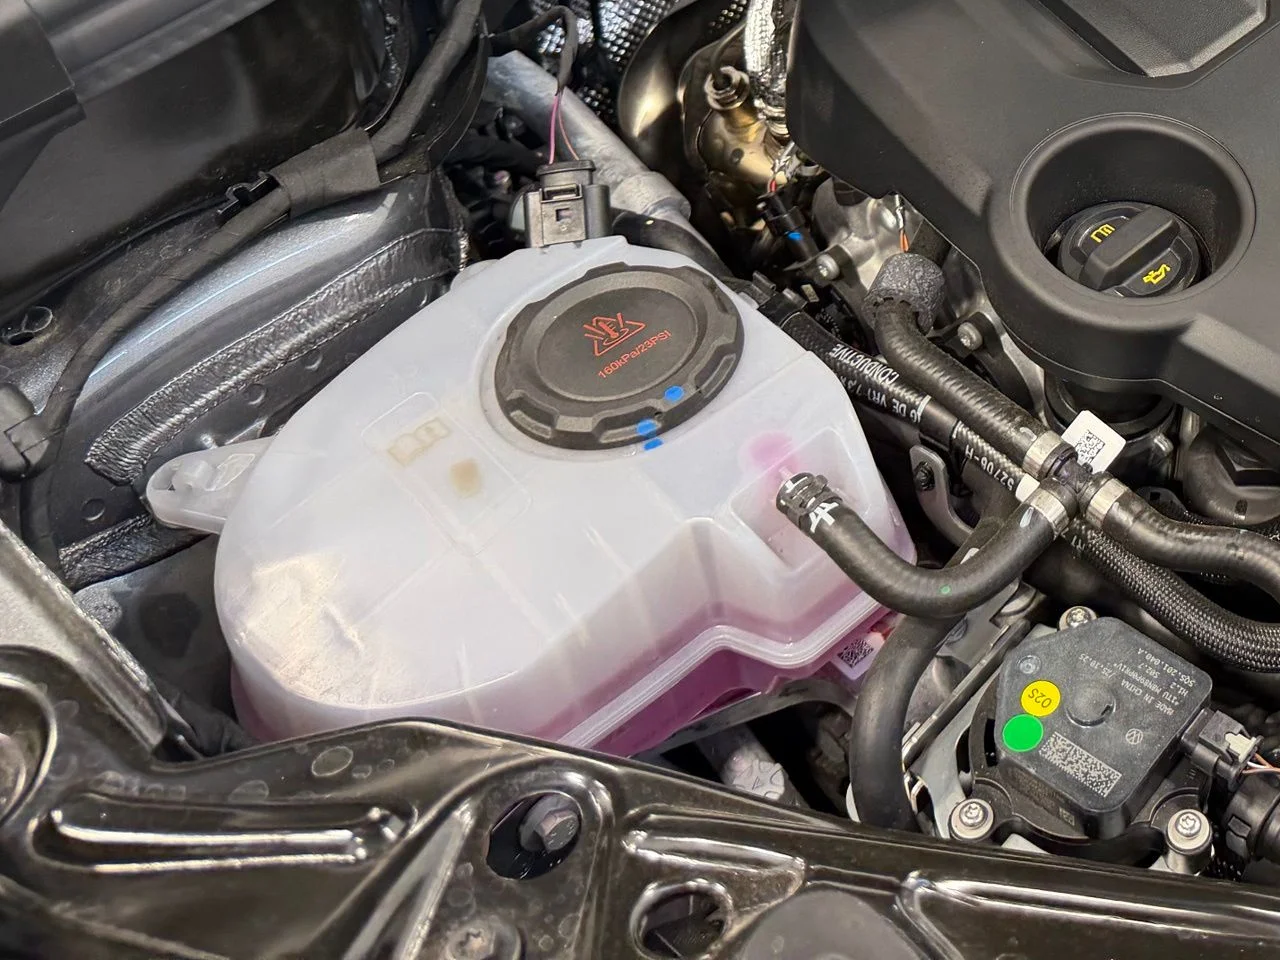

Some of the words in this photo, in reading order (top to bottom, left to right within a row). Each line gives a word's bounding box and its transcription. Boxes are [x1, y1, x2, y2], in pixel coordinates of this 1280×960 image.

[599, 329, 670, 378] 160kPa/23PSI
[830, 343, 898, 384] CONDUCTIVE
[1120, 678, 1142, 695] CHINA
[1143, 693, 1154, 703] IN
[1154, 700, 1174, 716] MADE
